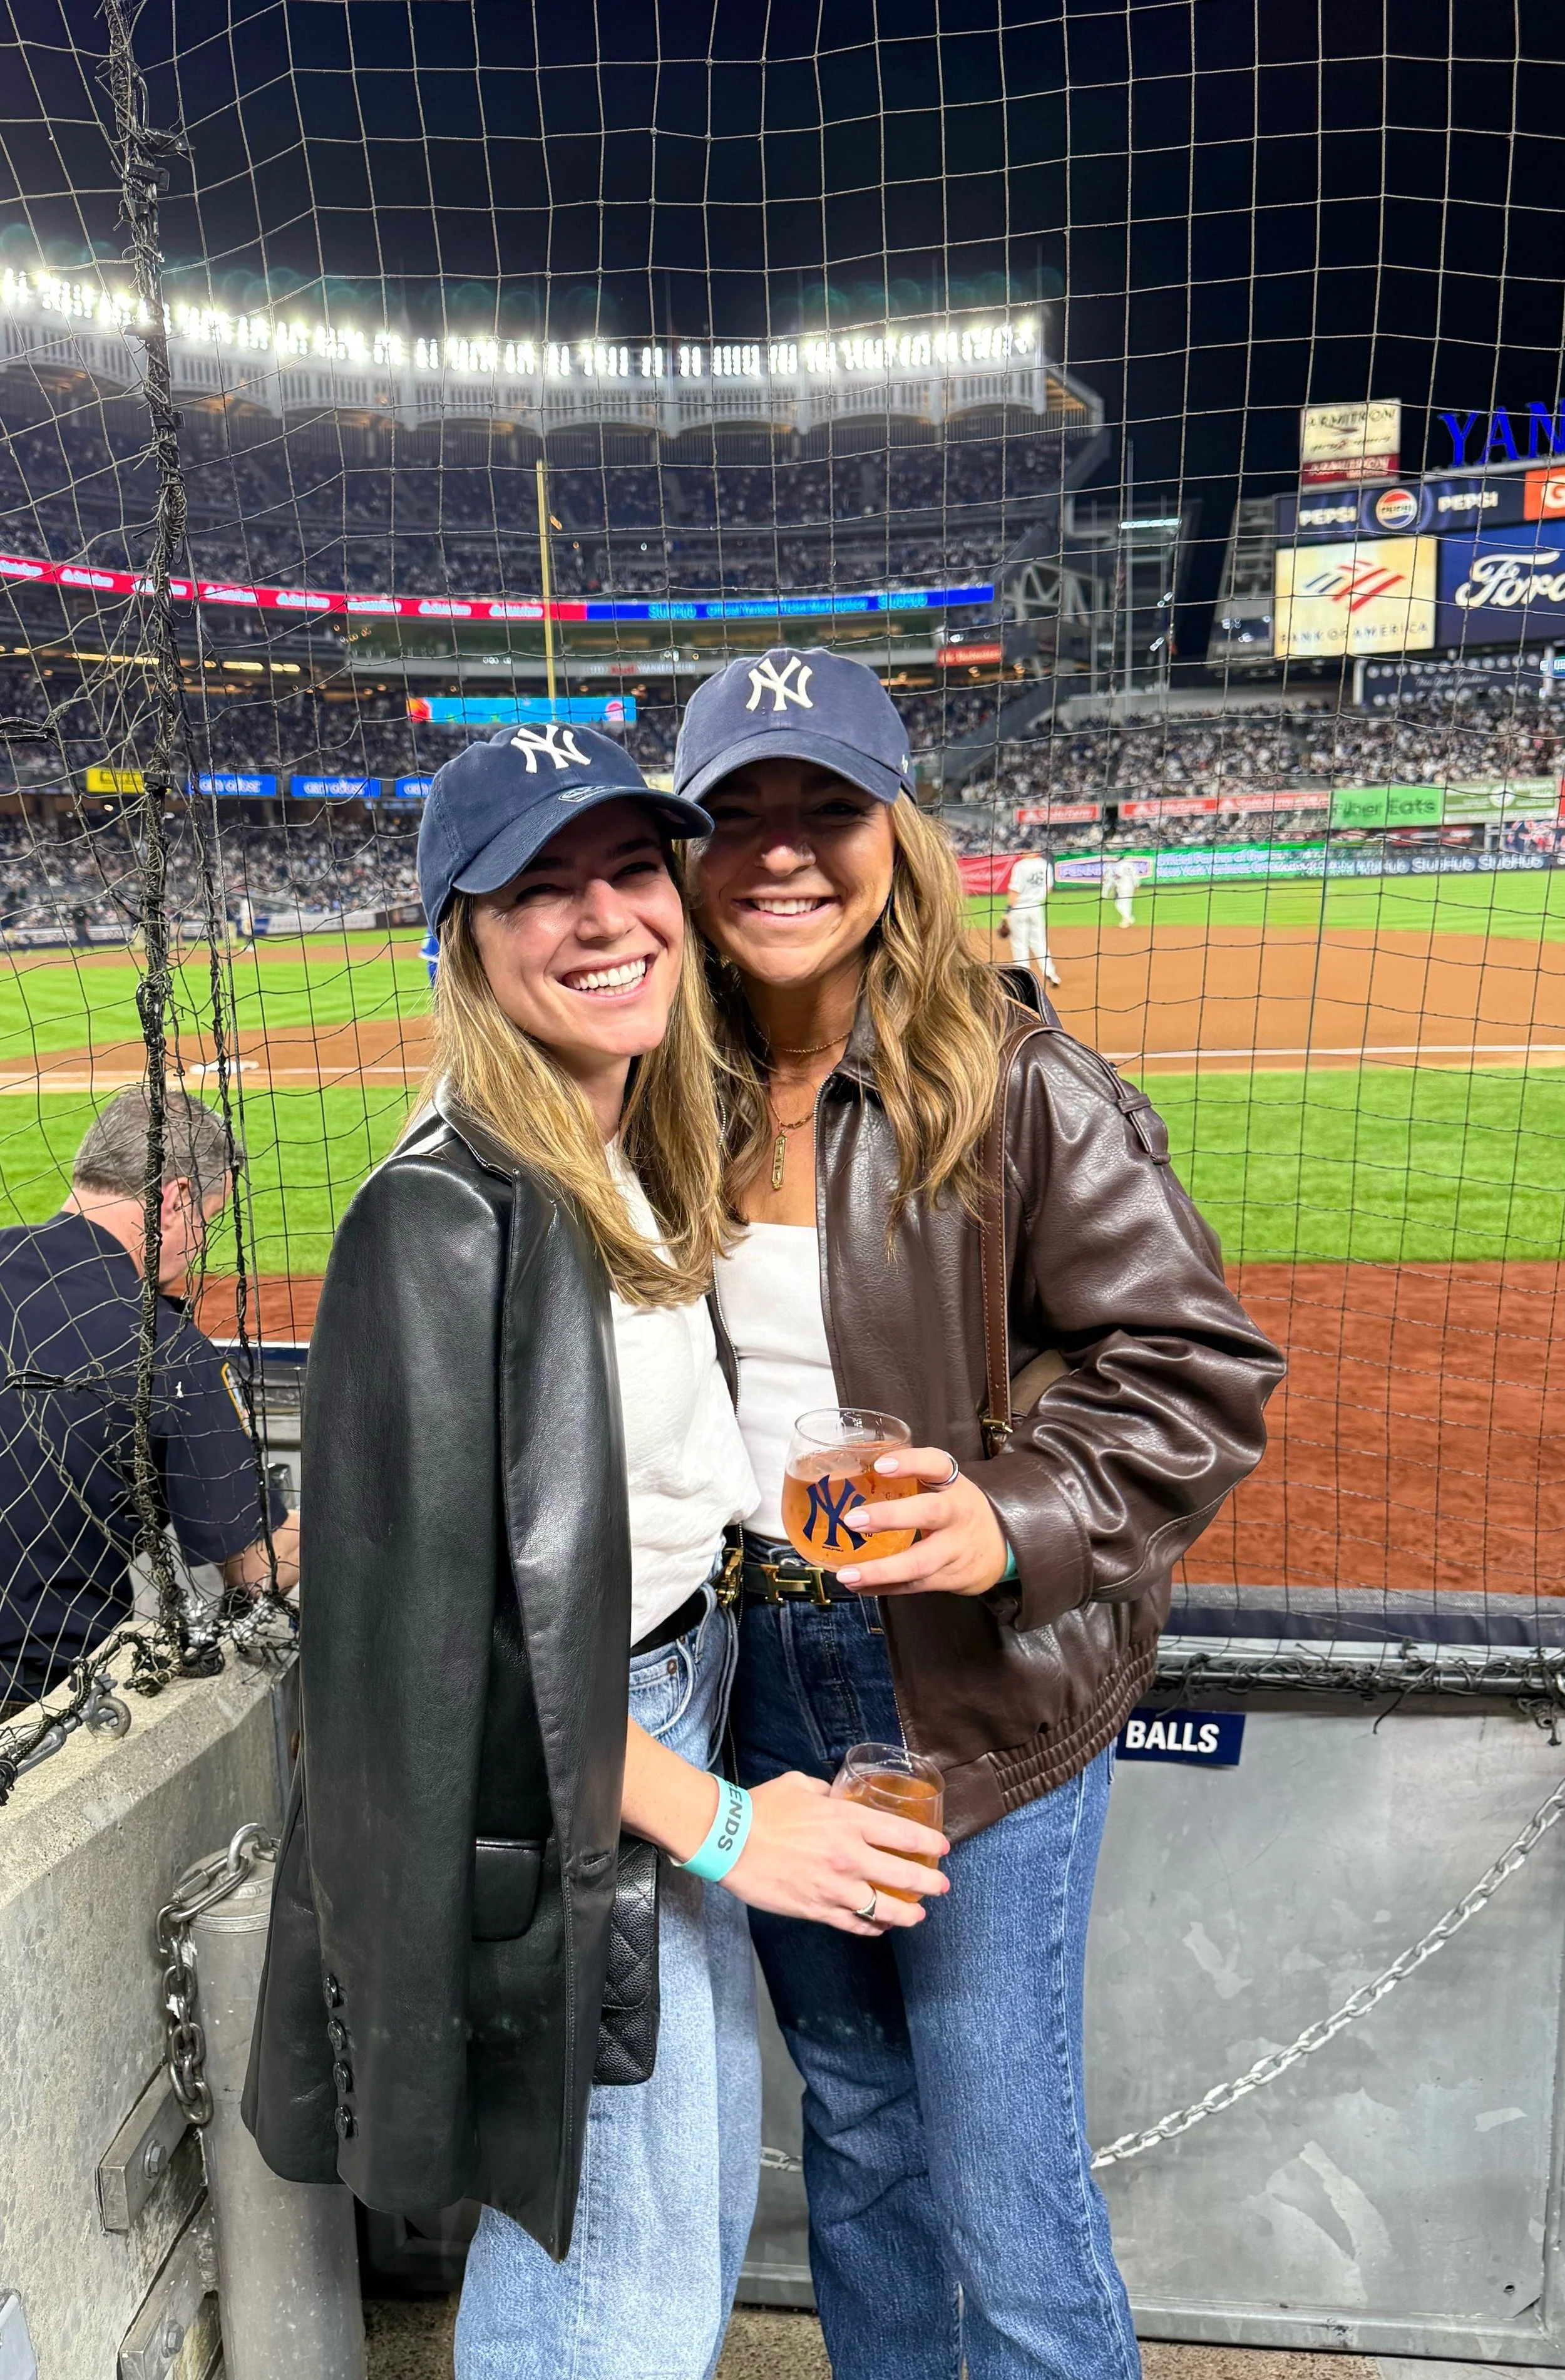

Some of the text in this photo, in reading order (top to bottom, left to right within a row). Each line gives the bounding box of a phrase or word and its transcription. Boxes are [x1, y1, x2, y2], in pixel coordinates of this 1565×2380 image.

[1299, 507, 1357, 527] PEPSI
[1438, 492, 1499, 512] PEPSI
[1353, 622, 1429, 639] AMERICA
[746, 656, 813, 711] NY
[511, 724, 592, 774] NY
[1389, 796, 1437, 816] Eats
[803, 1474, 868, 1551] NY
[1126, 1719, 1220, 1753] BALLS
[717, 1780, 743, 1852] ENDS
